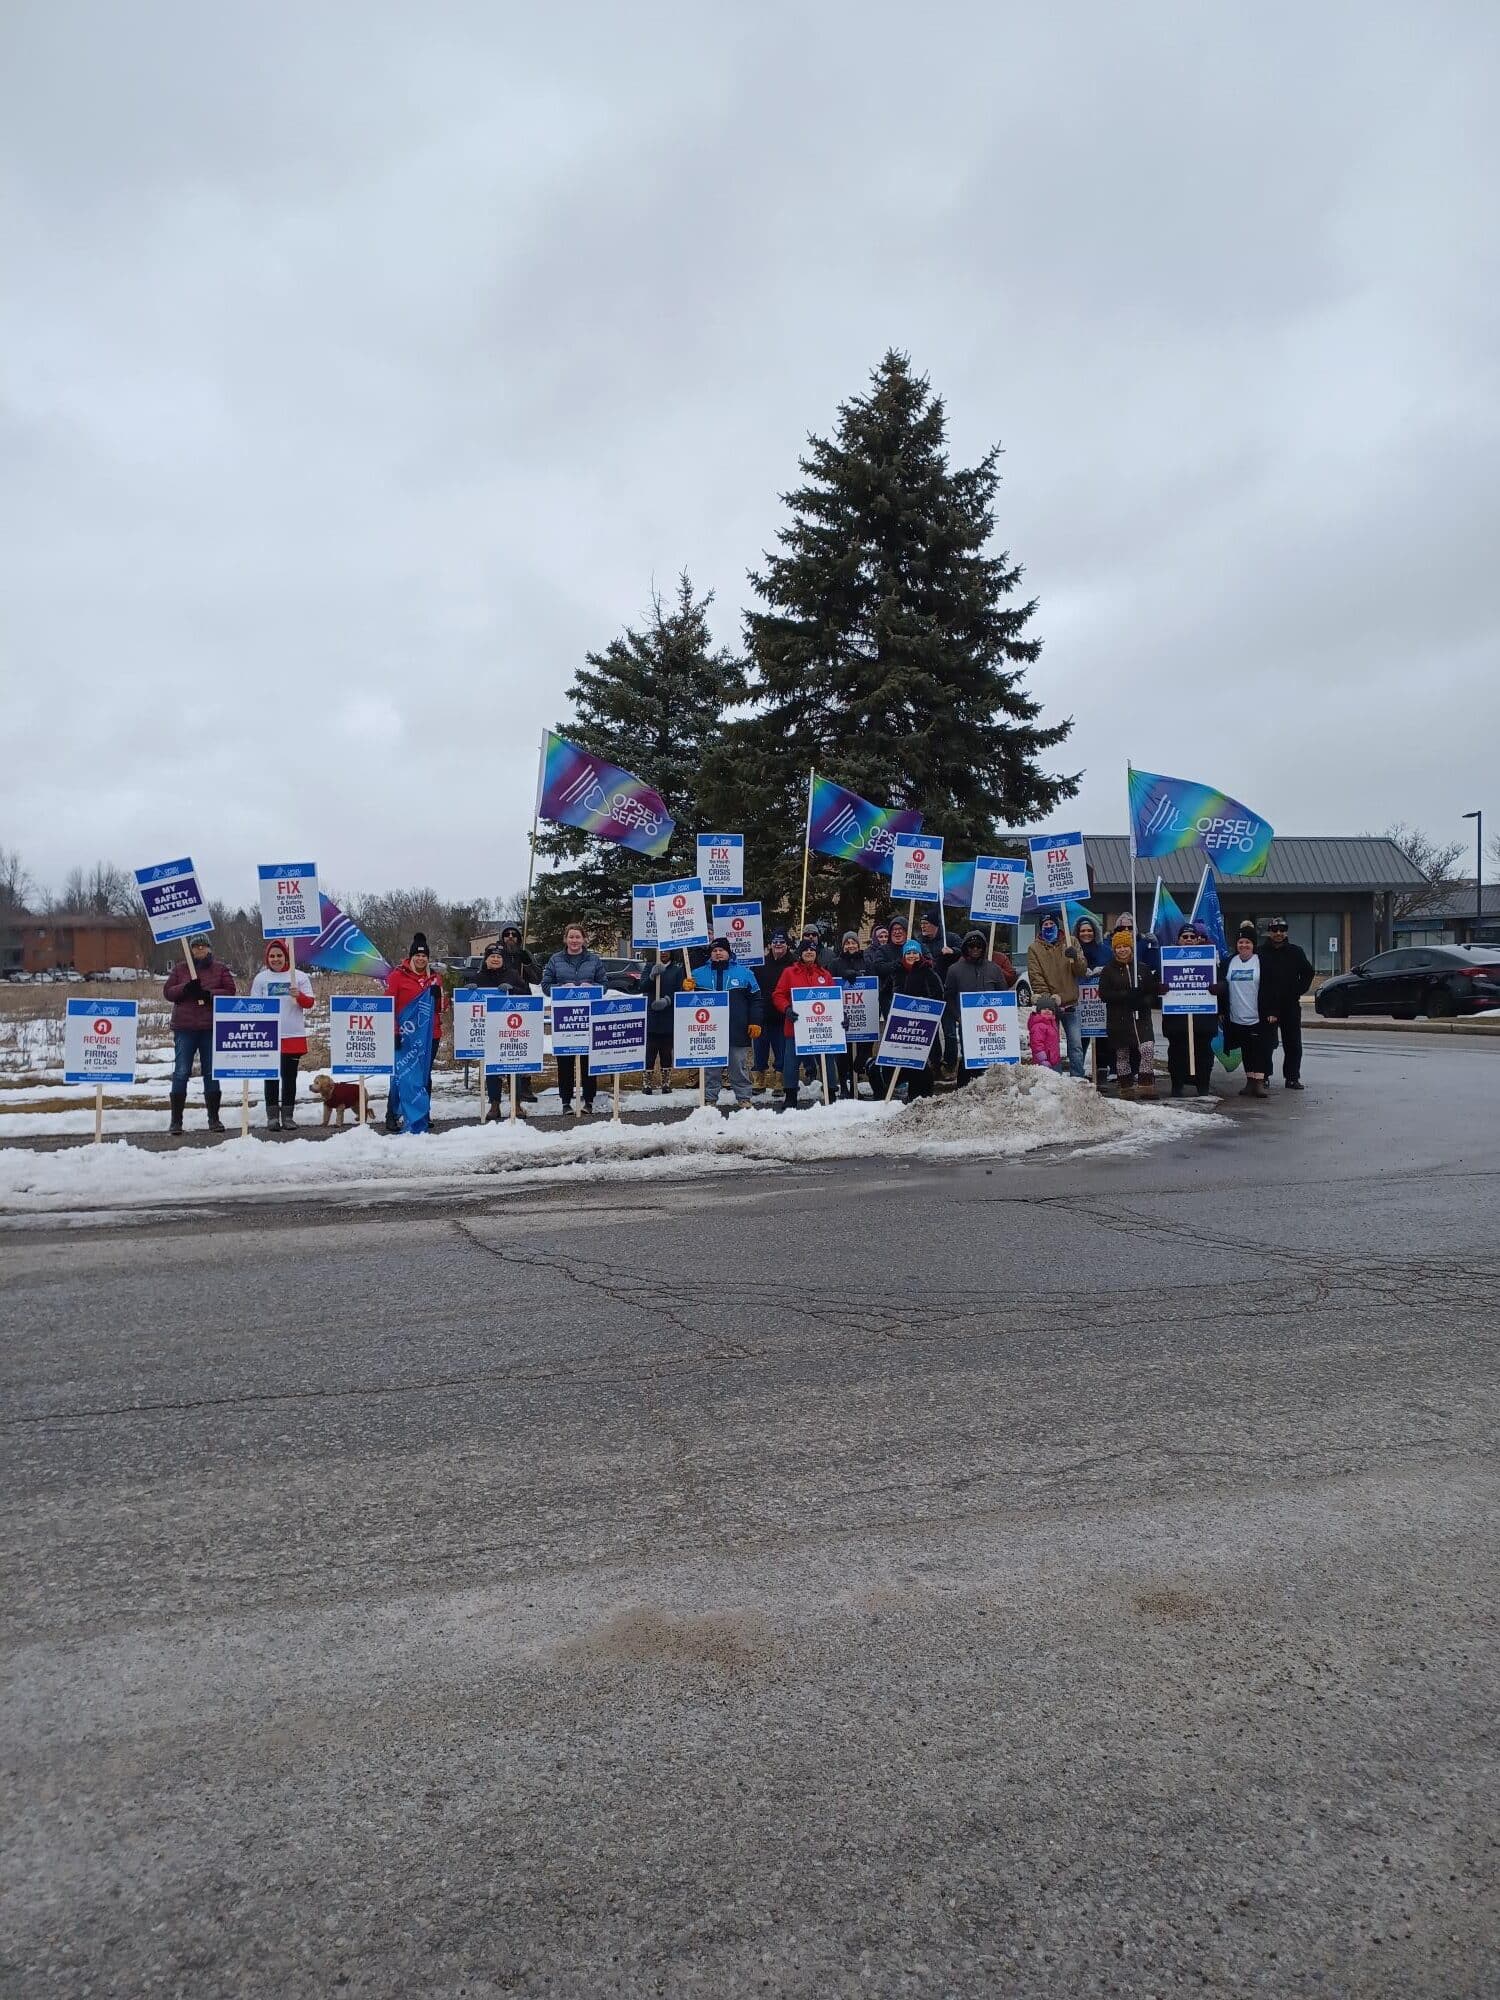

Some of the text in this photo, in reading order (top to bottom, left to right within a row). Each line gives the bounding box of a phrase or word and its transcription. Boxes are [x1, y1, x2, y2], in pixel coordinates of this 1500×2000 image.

[613, 793, 663, 825] OPSEU
[611, 807, 657, 836] SEFPO
[1196, 817, 1260, 836] OPSEU
[1204, 833, 1253, 852] EFPO
[711, 848, 729, 859] FIX
[1047, 850, 1068, 863] FIX
[989, 873, 1010, 885] FIX
[1048, 872, 1073, 882] CRISIS
[161, 885, 176, 893] MY
[277, 881, 301, 894] FIX
[154, 890, 189, 904] SAFETY
[985, 894, 1010, 902] CRISIS
[151, 896, 198, 914] MATTERS!
[277, 905, 305, 914] CRISIS
[1082, 988, 1100, 999] FIX
[844, 993, 864, 1005] FIX
[472, 1005, 484, 1017] FI
[1081, 1009, 1105, 1017] CRISIS
[240, 1023, 255, 1031] MY
[349, 1016, 374, 1029] FIX
[897, 1026, 926, 1035] SAFETY
[976, 1024, 1007, 1032] REVERSE
[83, 1036, 121, 1044] REVERSE
[228, 1032, 268, 1040] SAFETY
[890, 1033, 928, 1043] MATTERS!
[222, 1041, 273, 1049] MATTERS!
[346, 1042, 376, 1051] CRISIS
[595, 1037, 643, 1046] IMPORTANTE!
[84, 1050, 118, 1058] FIRINGS
